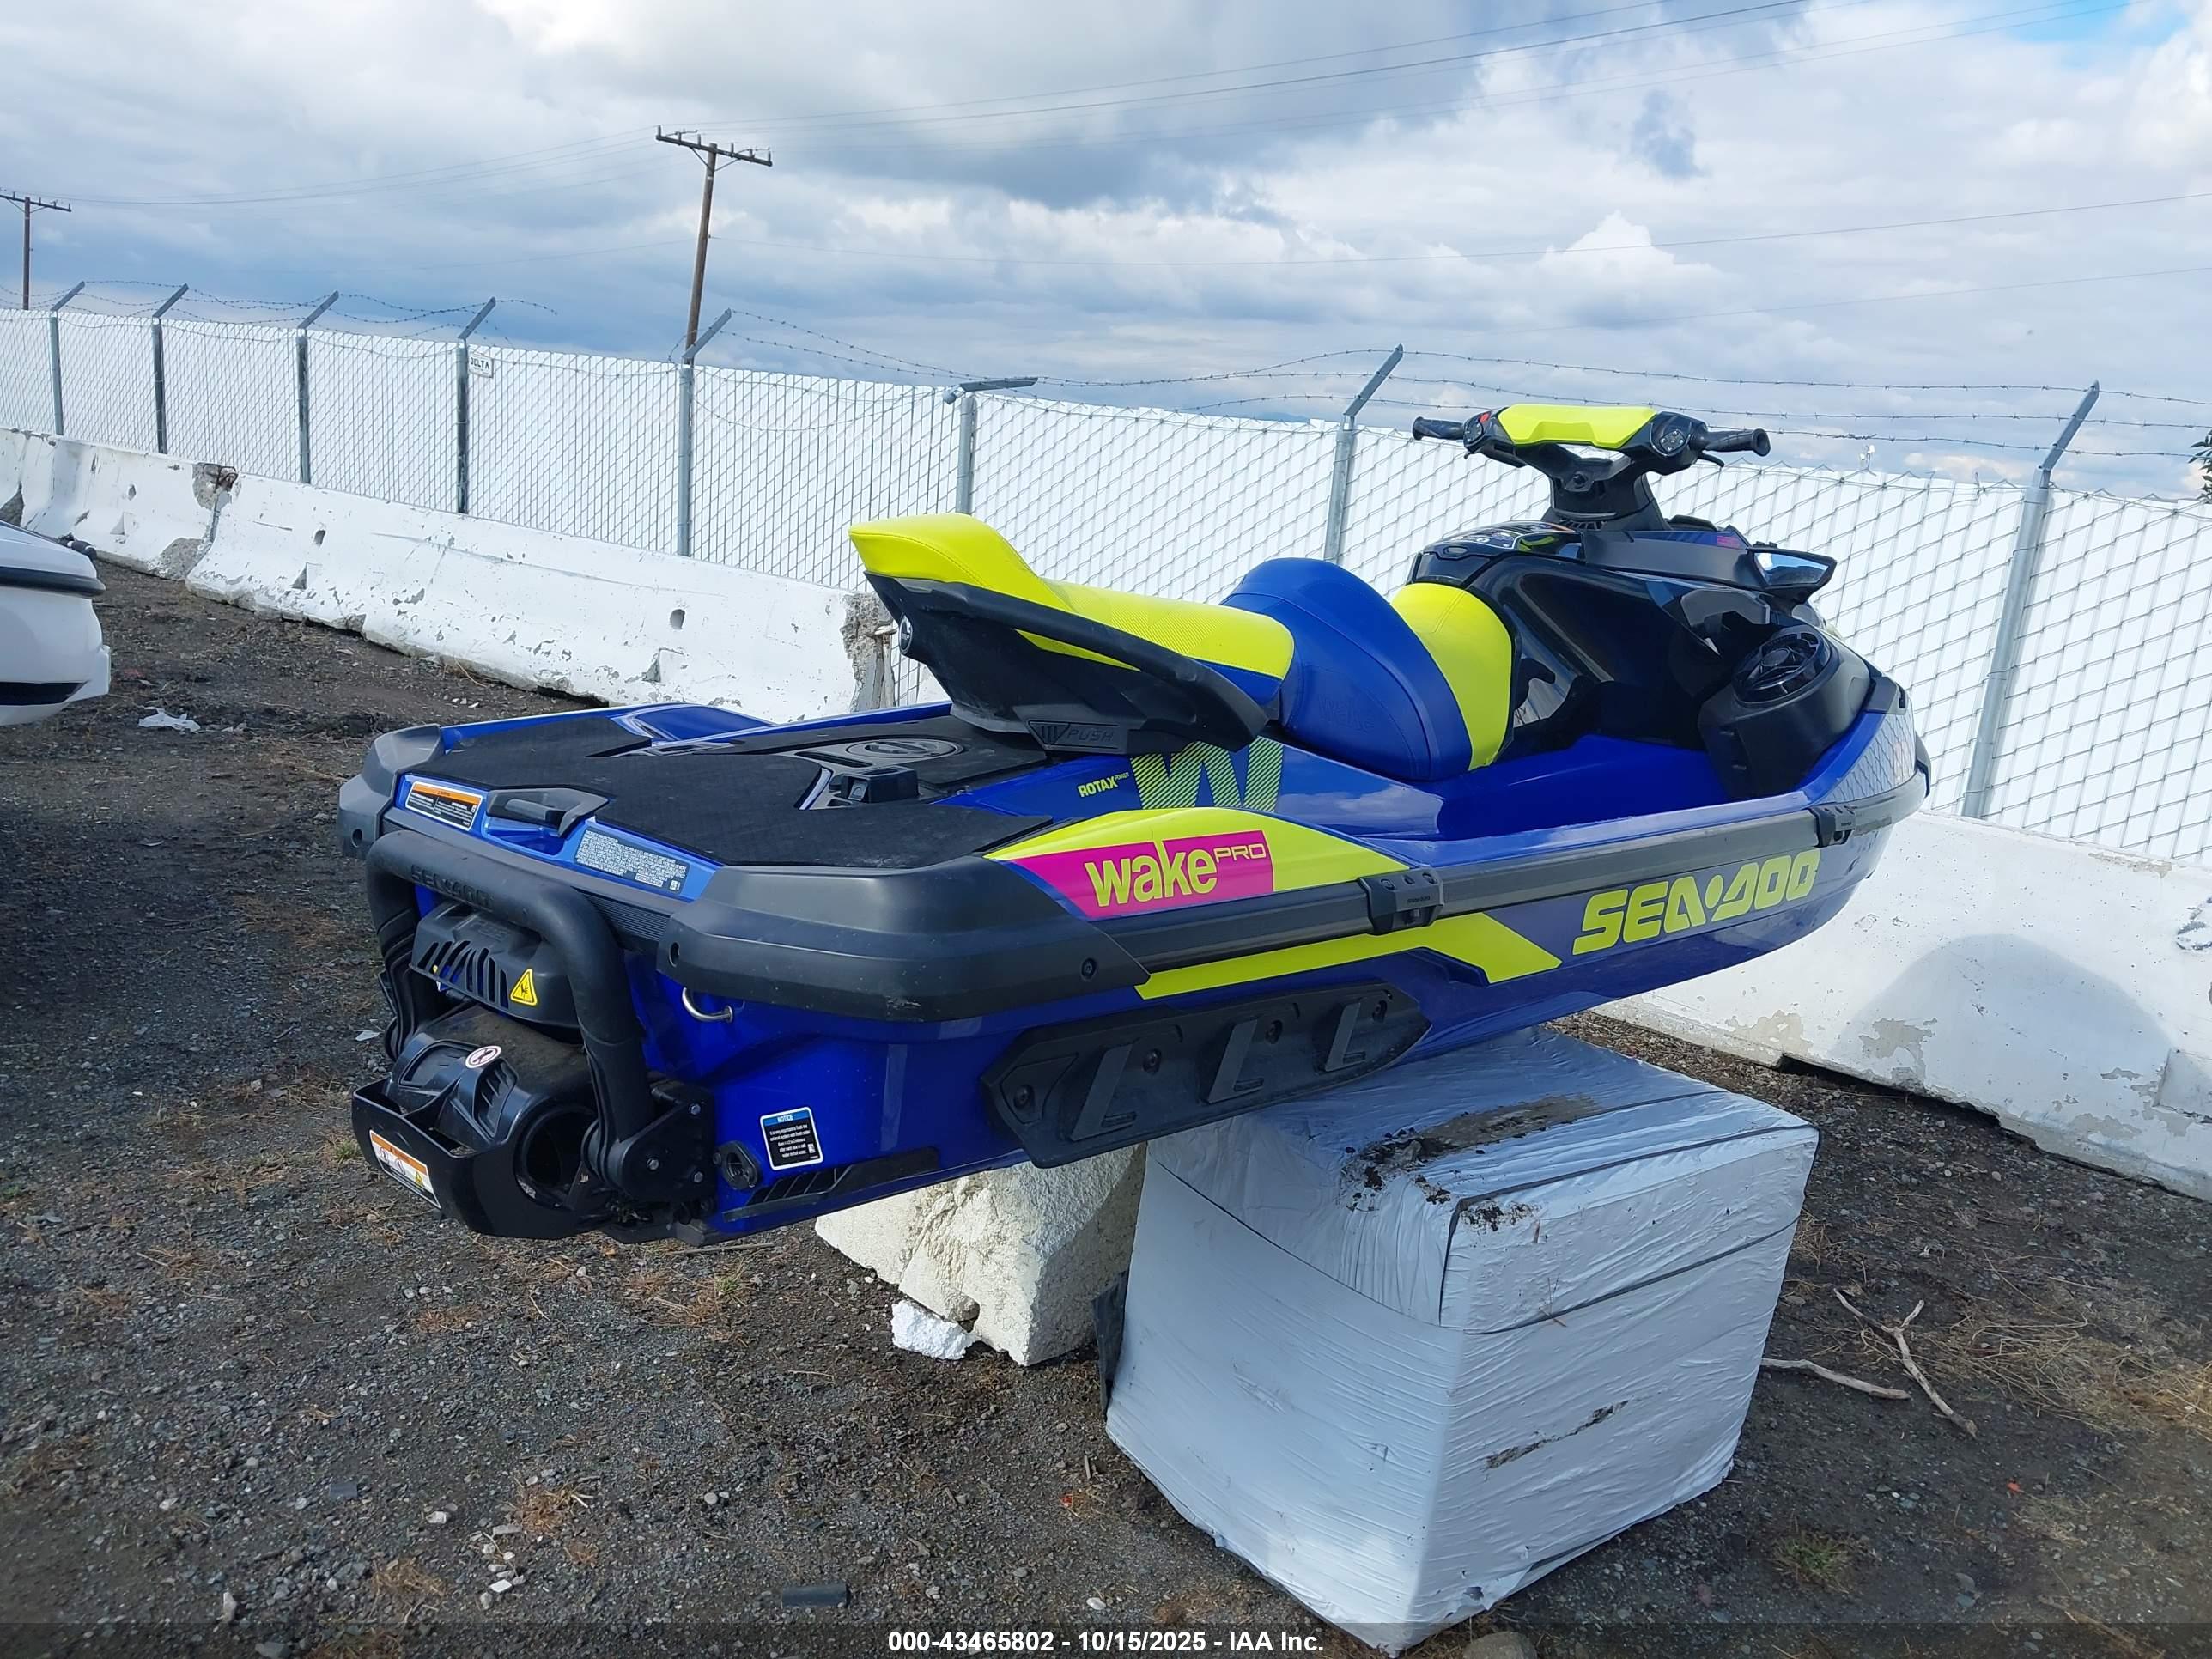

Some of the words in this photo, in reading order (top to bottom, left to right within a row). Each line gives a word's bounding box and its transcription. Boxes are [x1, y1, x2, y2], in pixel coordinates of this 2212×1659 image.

[470, 356, 489, 369] DELTA
[1067, 729, 1114, 742] PUSH
[1078, 776, 1118, 797] ROTAX
[1084, 841, 1218, 908] wake
[1213, 843, 1267, 863] PRO
[777, 1114, 793, 1123] NOTICE
